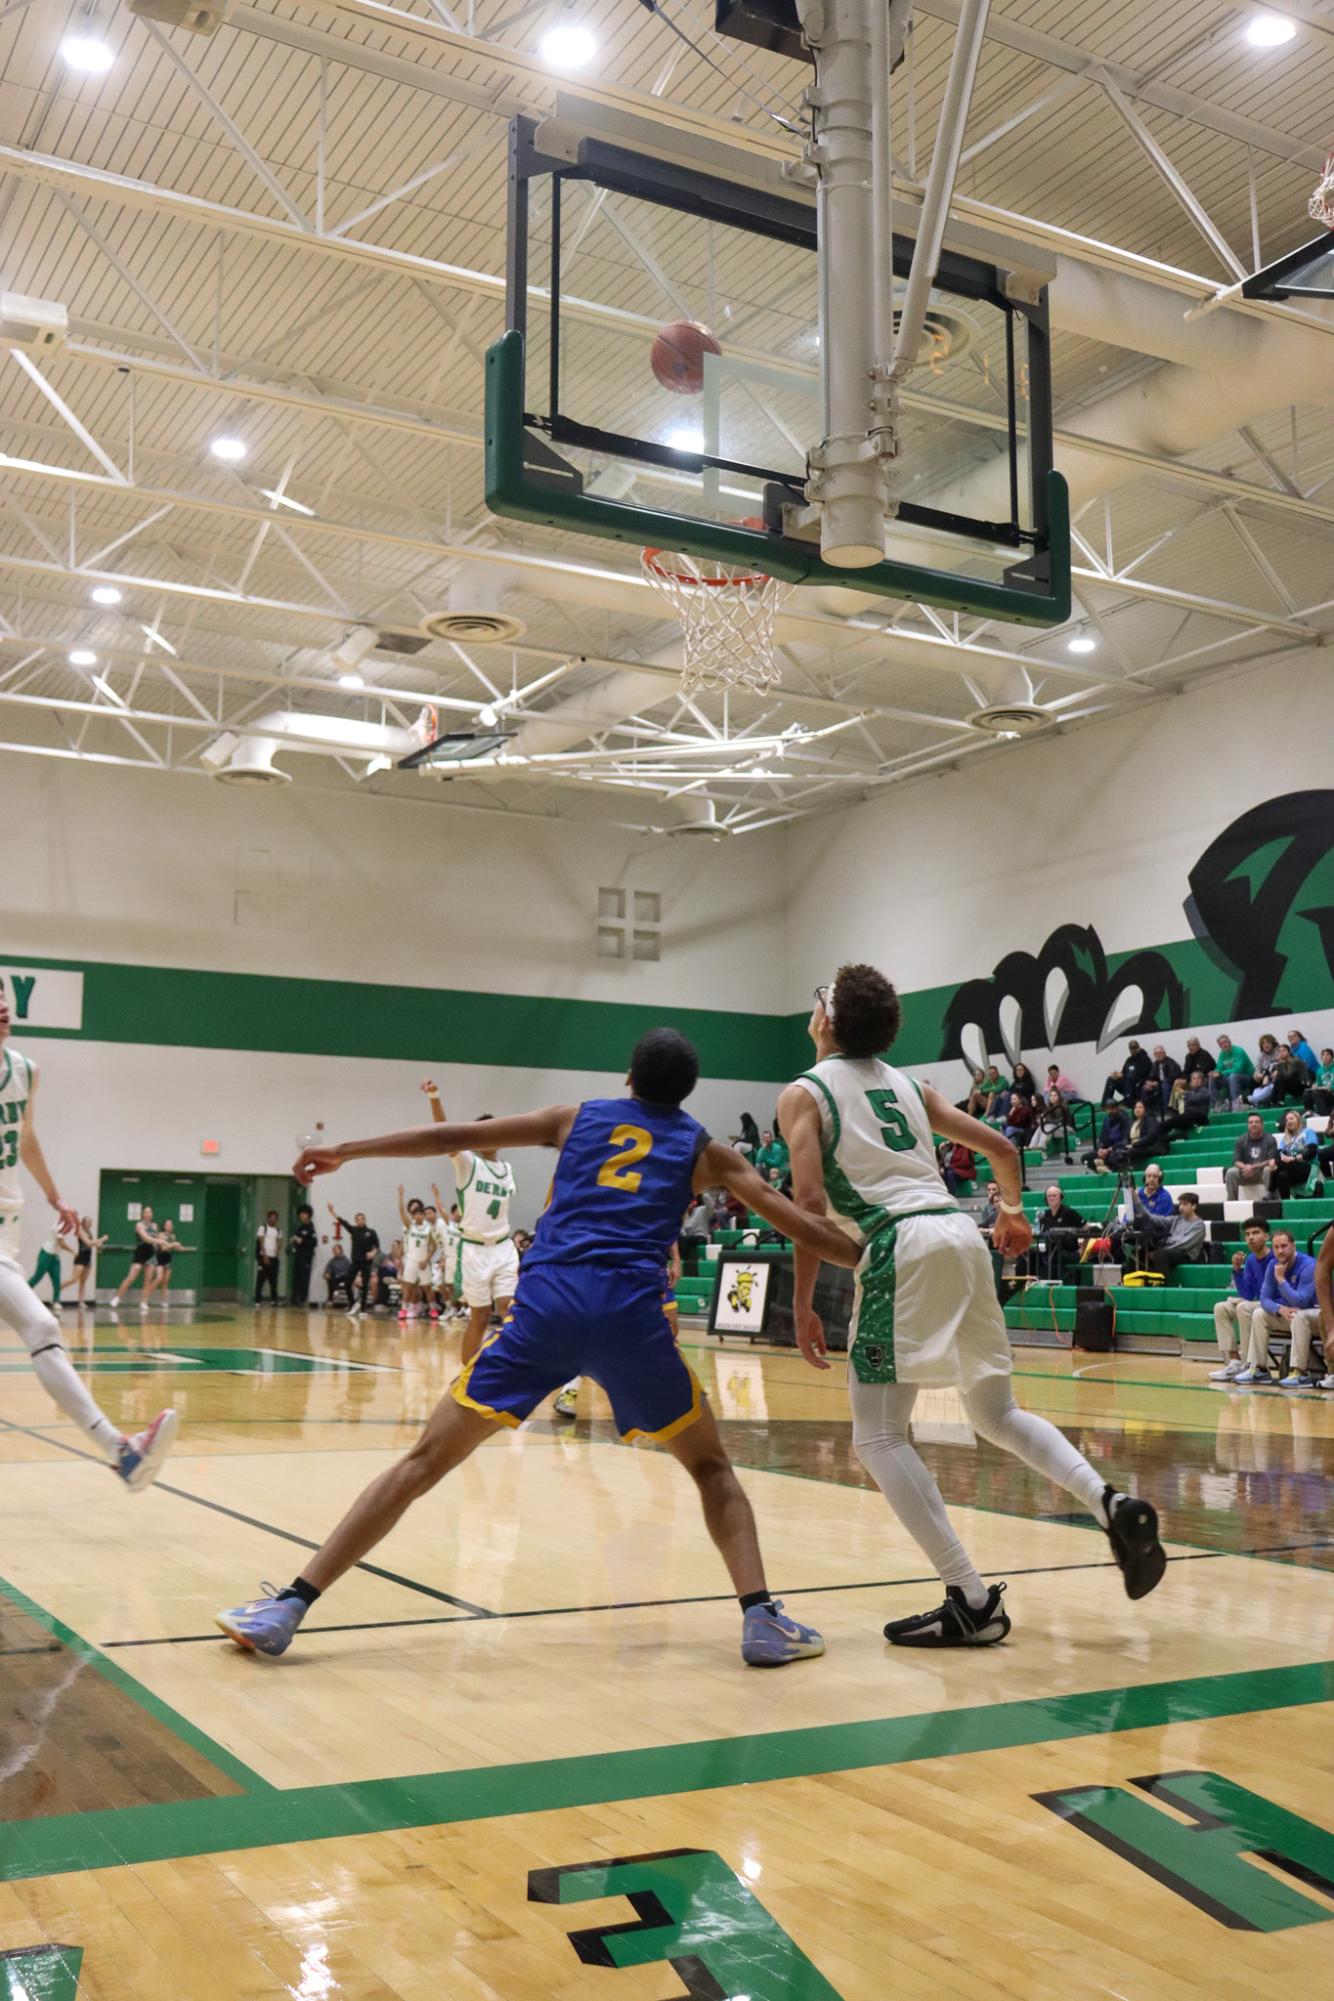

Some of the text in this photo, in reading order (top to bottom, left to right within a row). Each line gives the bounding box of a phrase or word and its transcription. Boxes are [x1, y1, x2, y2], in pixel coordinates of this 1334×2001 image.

[864, 1088, 918, 1152] 5
[596, 1123, 654, 1194] 2
[486, 1199, 502, 1220] 4
